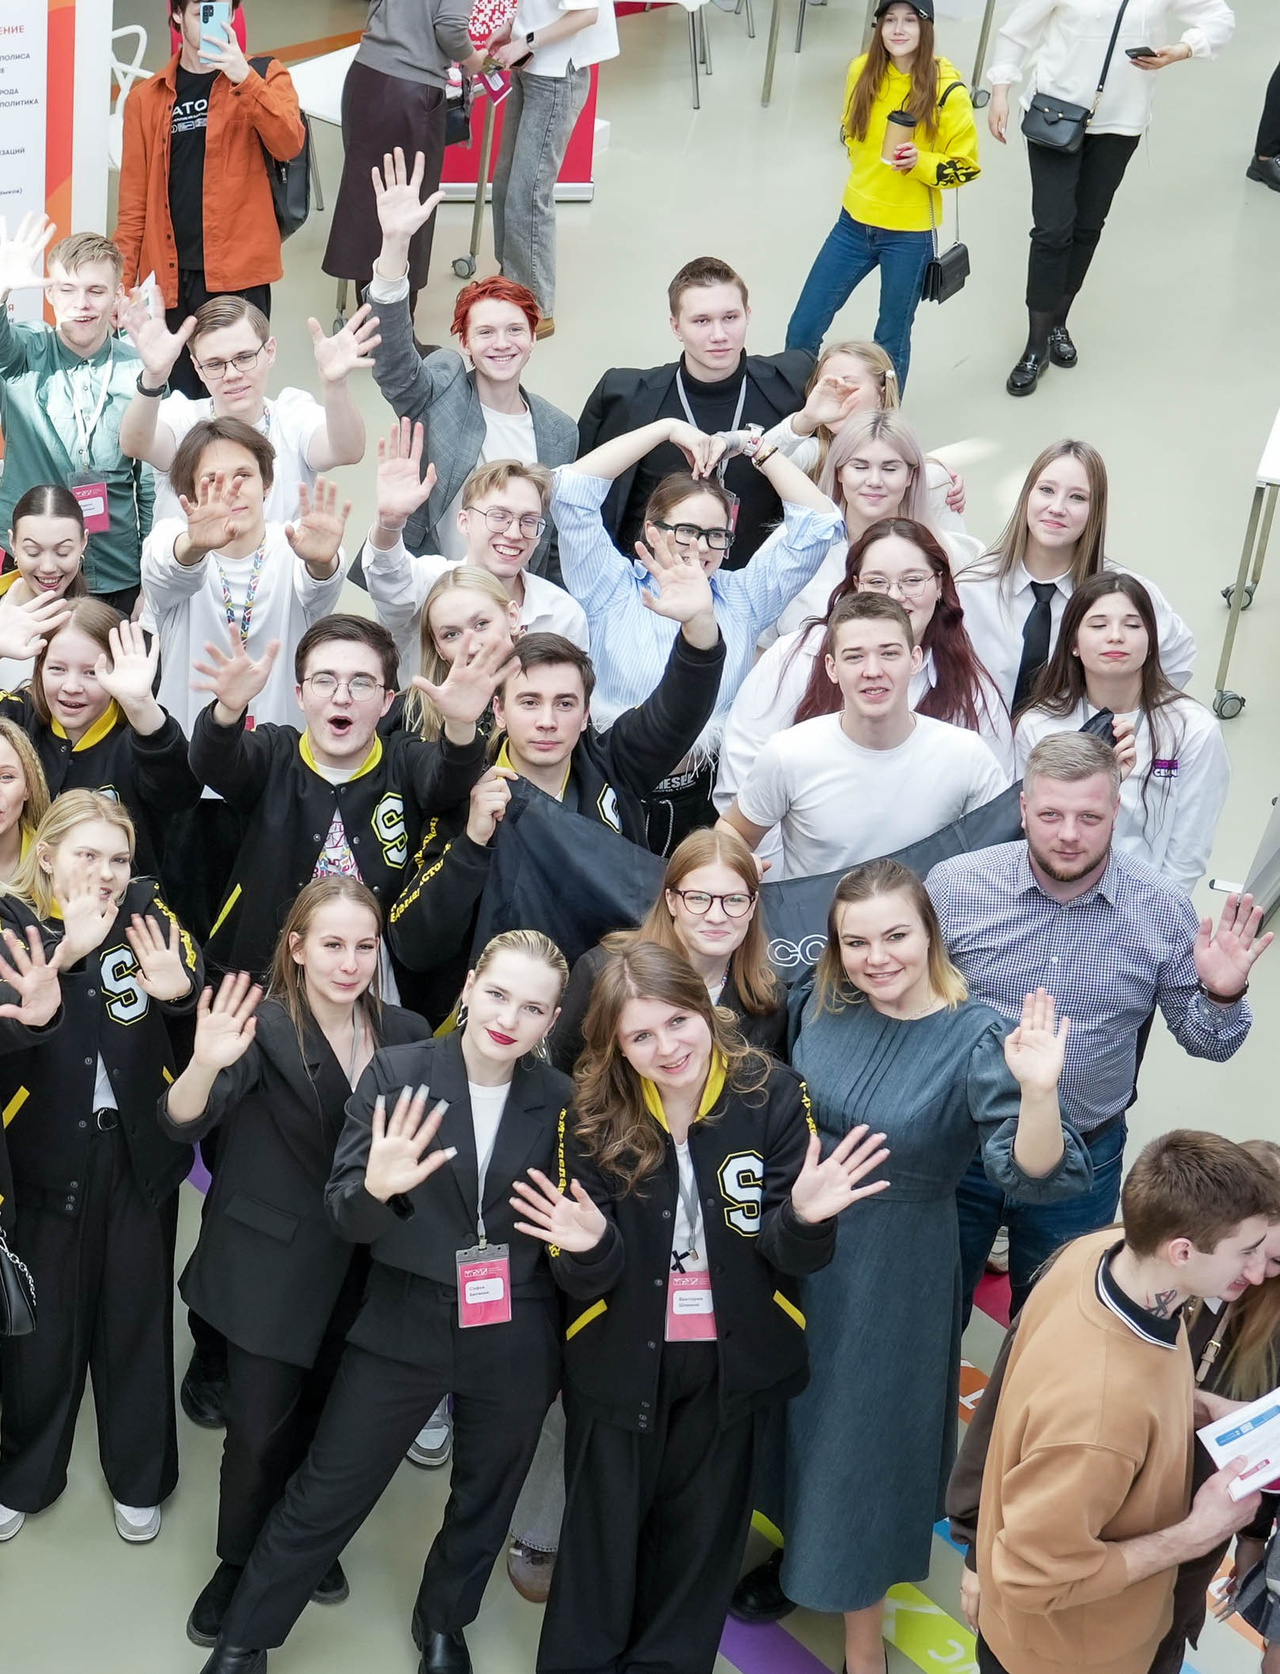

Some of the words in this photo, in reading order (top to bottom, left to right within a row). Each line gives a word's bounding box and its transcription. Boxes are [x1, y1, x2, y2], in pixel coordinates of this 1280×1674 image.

[0, 99, 39, 108] ПОЛИТИКА
[656, 773, 694, 790] IESEL
[100, 943, 150, 1026] S
